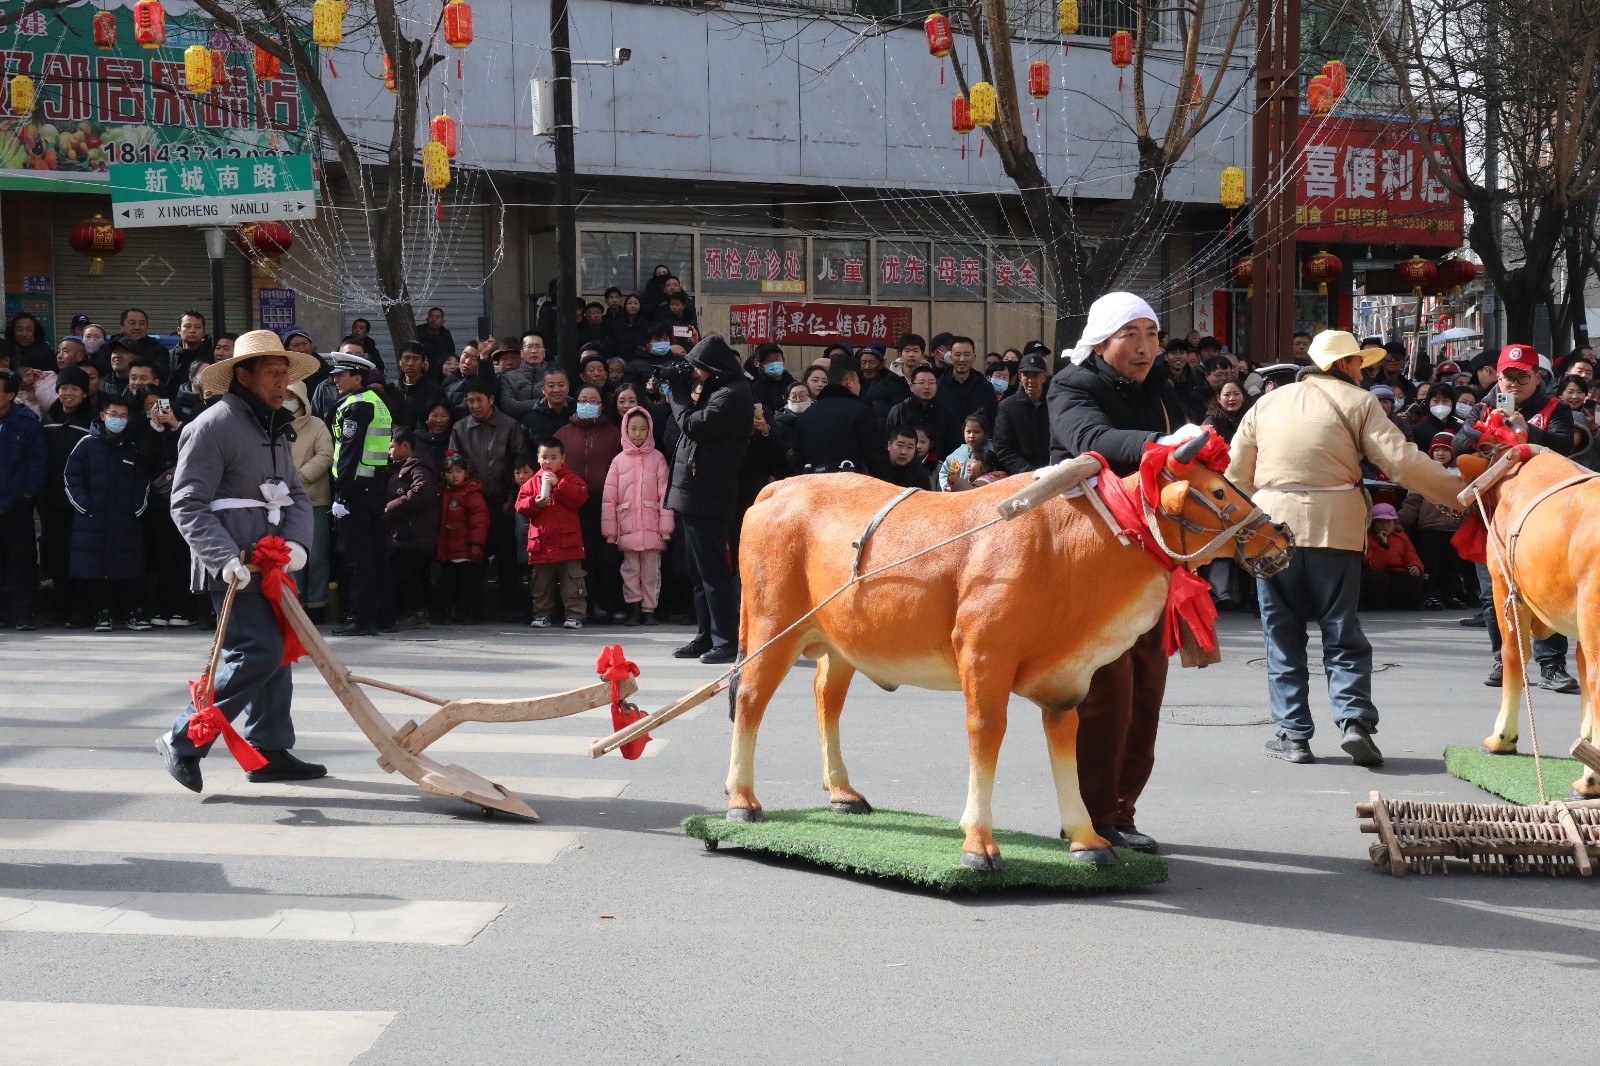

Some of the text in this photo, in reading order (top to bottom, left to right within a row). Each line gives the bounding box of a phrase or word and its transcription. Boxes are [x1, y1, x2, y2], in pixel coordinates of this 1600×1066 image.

[145, 164, 276, 193] 新城南路
[134, 201, 294, 220] 南 XINCHENG NANLU 北
[705, 248, 801, 281] 预检分诊处
[818, 255, 1038, 286] 儿童 优先 母亲 安全
[776, 304, 787, 340] 八卦炉
